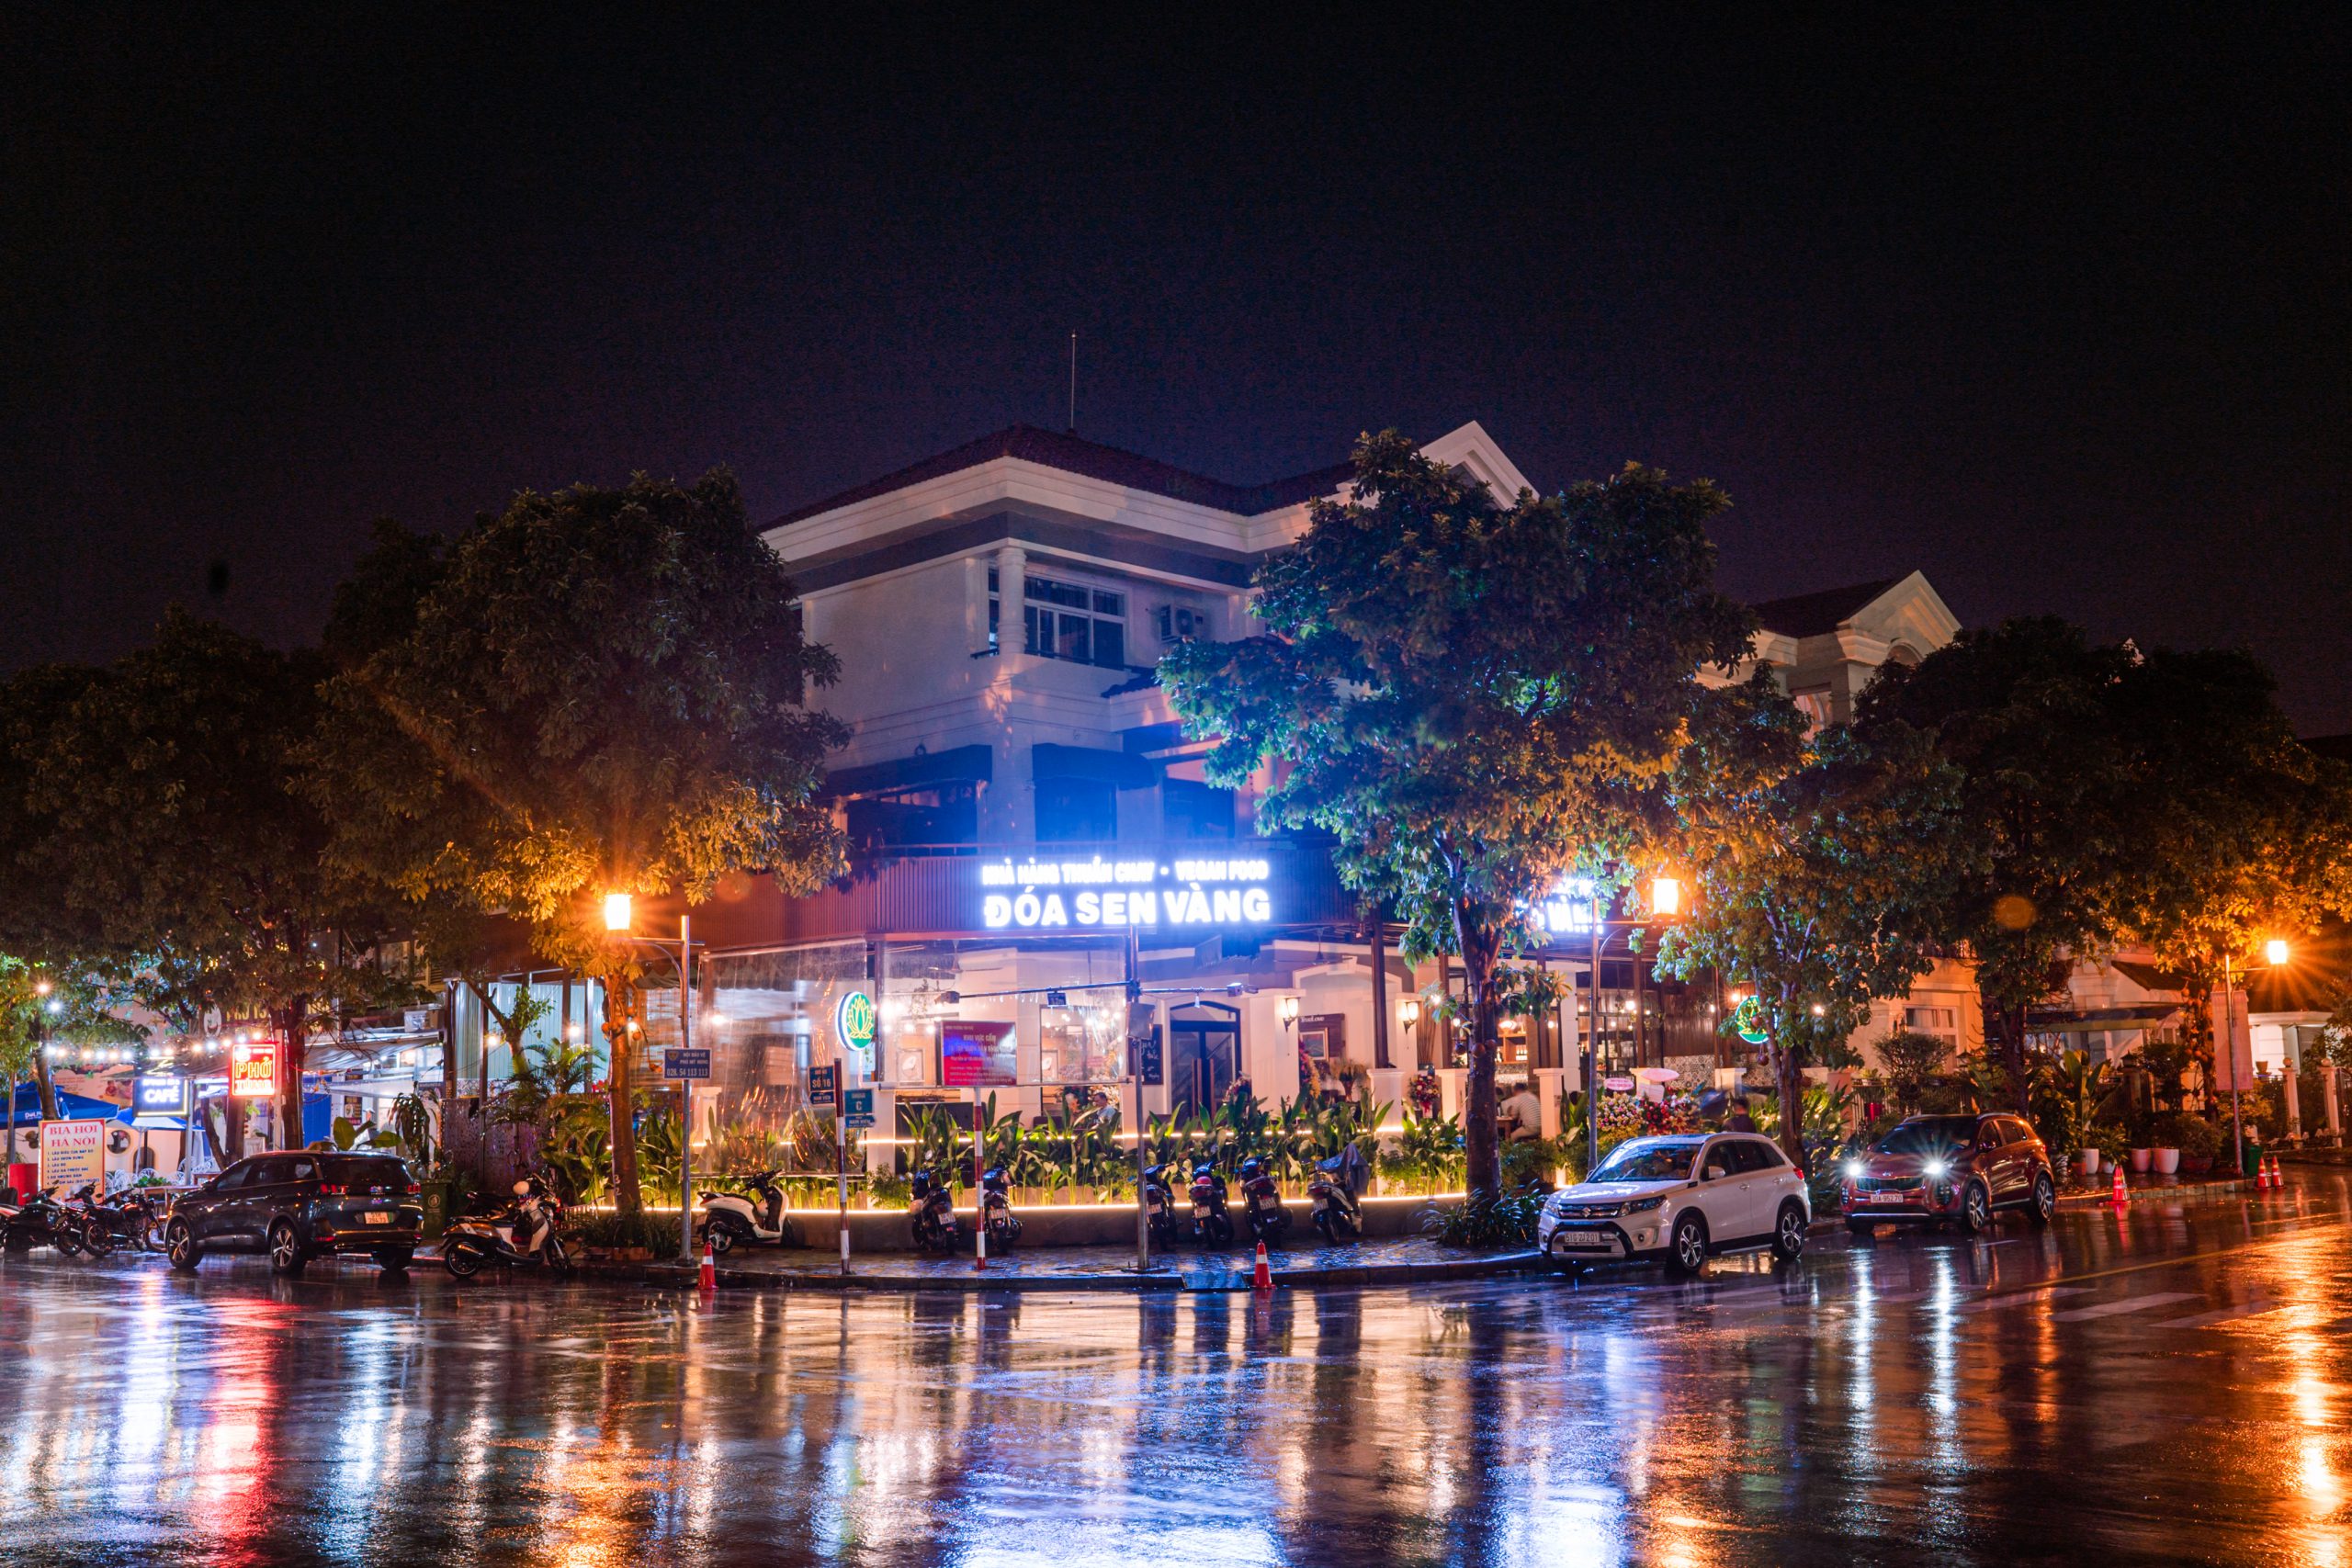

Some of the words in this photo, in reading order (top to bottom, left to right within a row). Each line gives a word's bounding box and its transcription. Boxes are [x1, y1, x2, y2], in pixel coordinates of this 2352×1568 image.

[1017, 857, 1059, 885] HÀNG
[1114, 861, 1155, 883] CHAY
[1175, 861, 1227, 881] VEGAN
[1228, 860, 1269, 881] FOOD
[984, 885, 1069, 928] ĐÓA
[1075, 891, 1157, 926] SEN
[1163, 882, 1271, 923] VÀNG
[235, 1055, 273, 1079] PHỞ
[812, 1076, 820, 1088] SỐ
[822, 1078, 831, 1088] 16
[144, 1086, 179, 1102] CAFÉ
[855, 1100, 863, 1111] C
[50, 1126, 70, 1135] BIA
